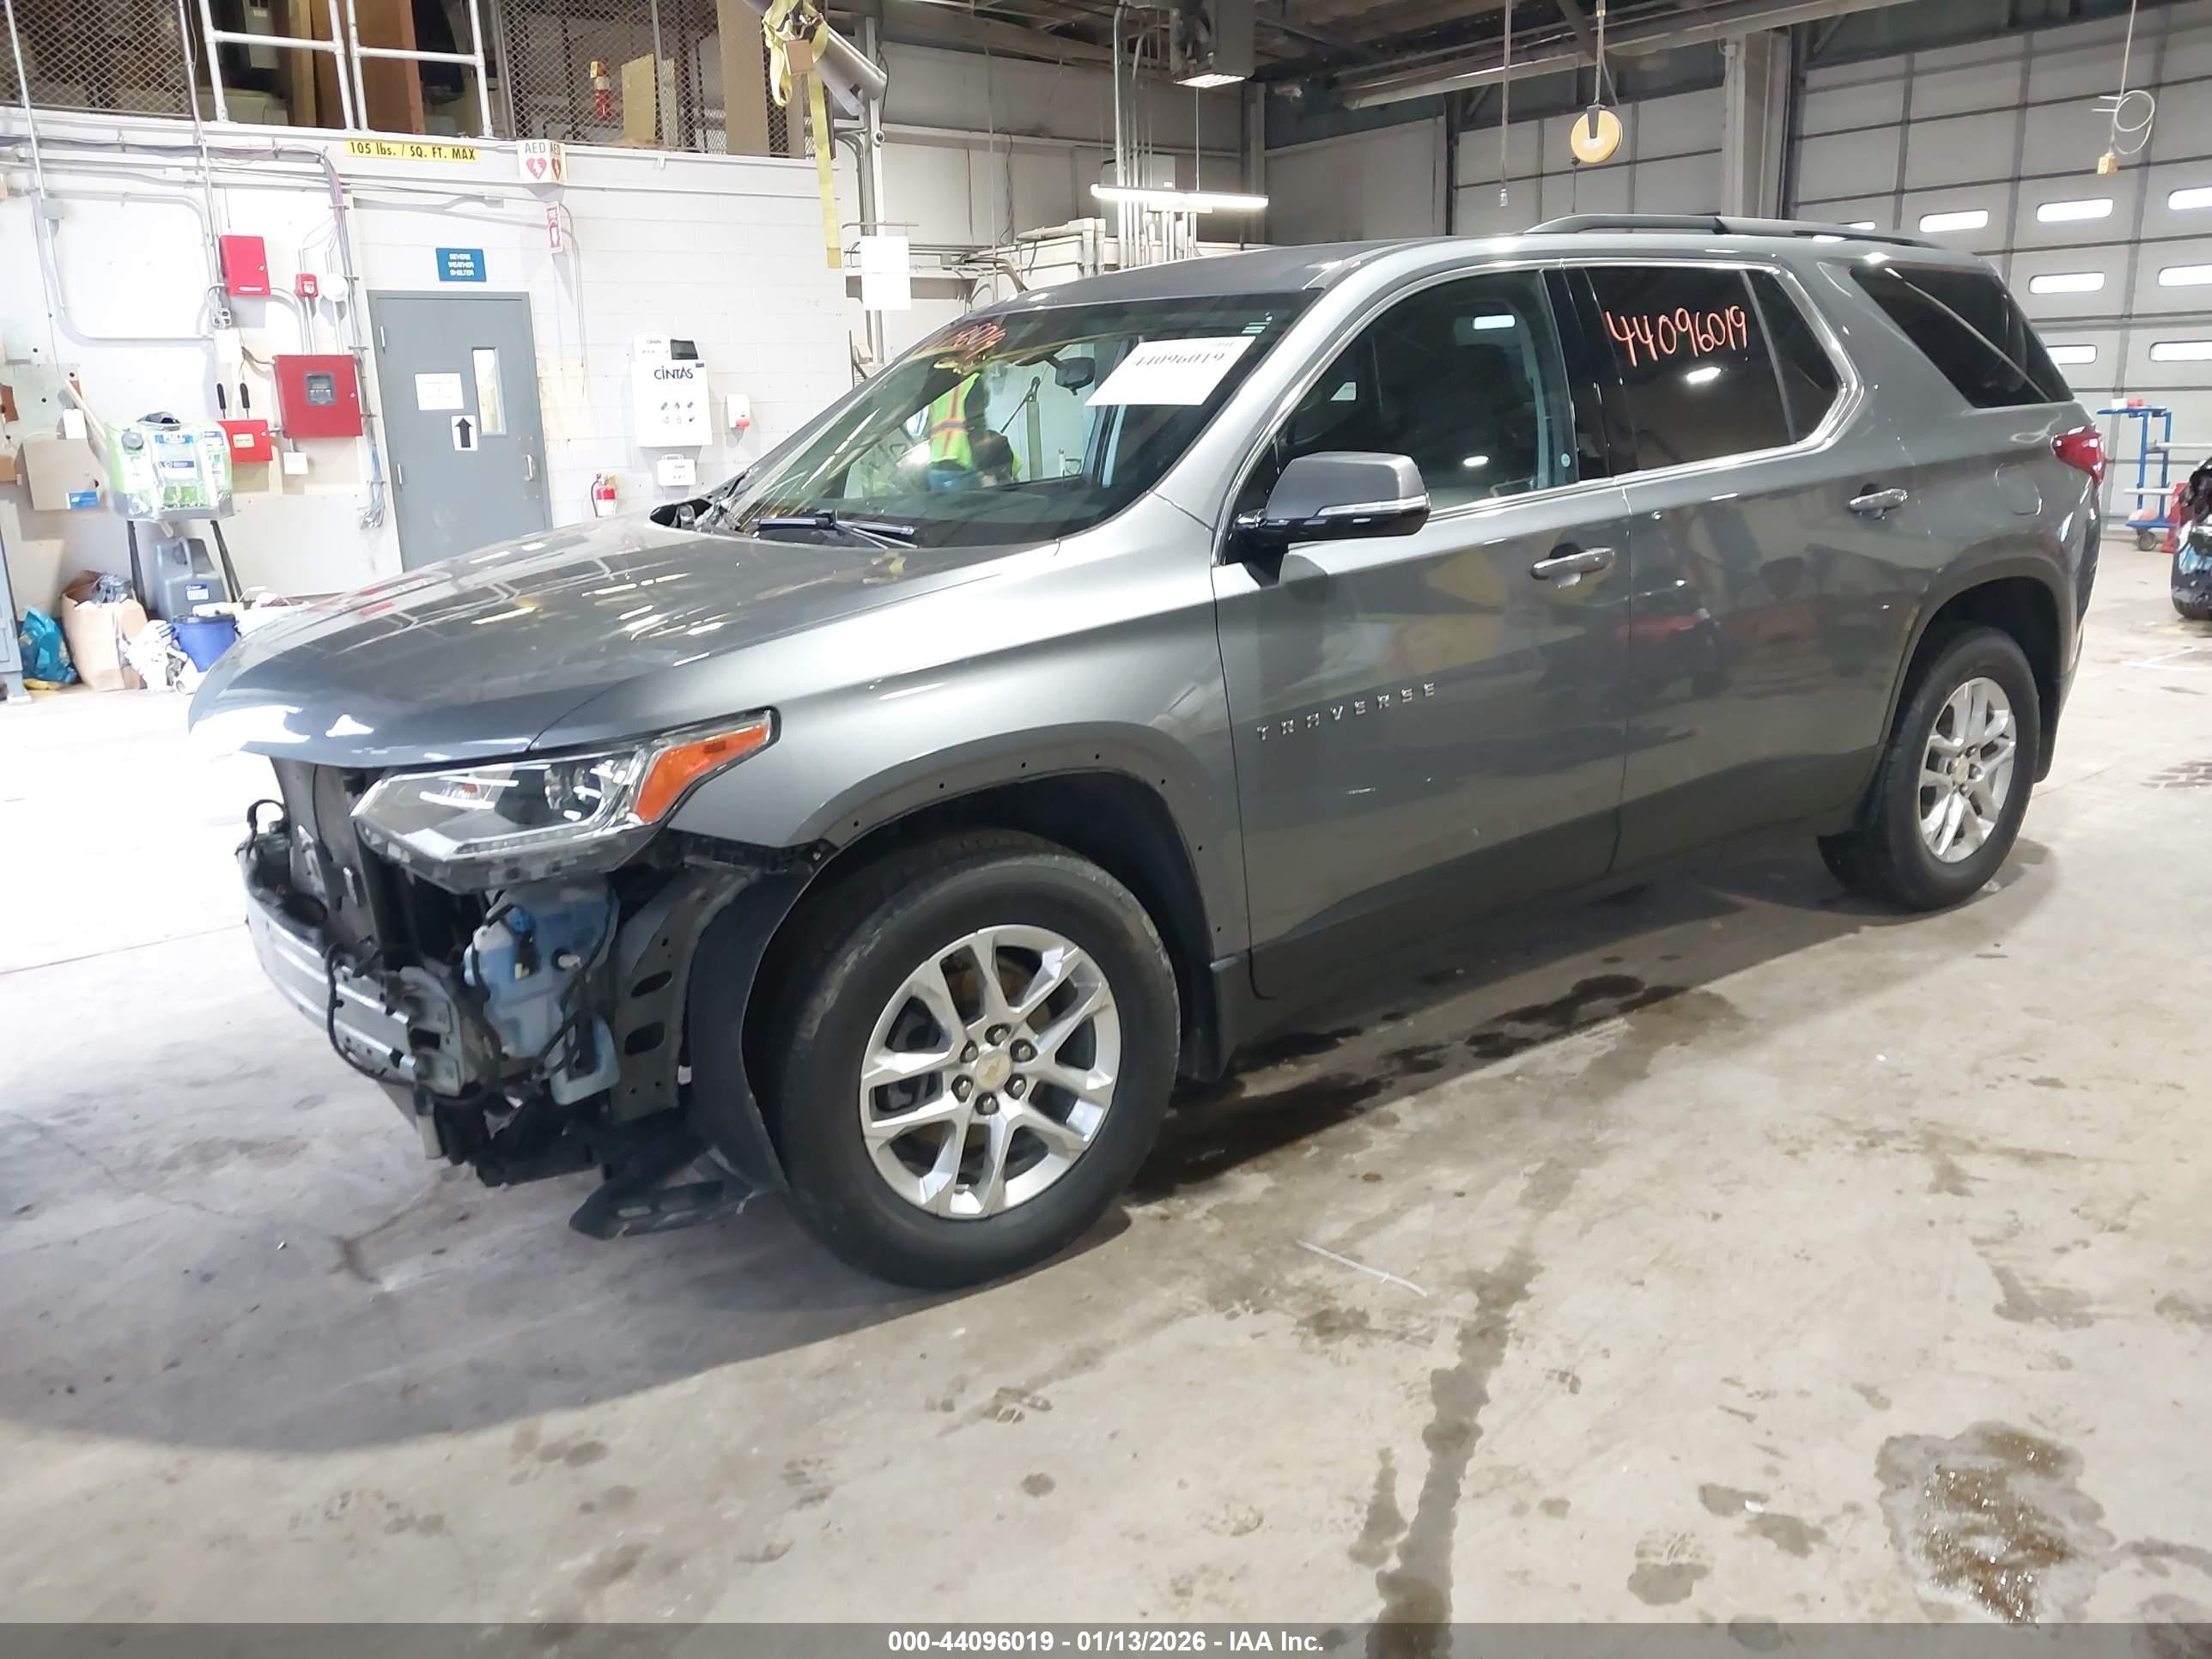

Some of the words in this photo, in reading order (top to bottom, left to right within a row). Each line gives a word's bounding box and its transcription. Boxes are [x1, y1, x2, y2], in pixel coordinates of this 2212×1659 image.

[350, 142, 371, 154] 105
[376, 143, 396, 155] lbs.
[401, 143, 405, 156] /
[410, 145, 428, 159] SQ.
[432, 147, 447, 159] FT.
[452, 148, 476, 160] MAX
[525, 142, 546, 154] AED
[550, 143, 561, 155] AED
[1605, 305, 1748, 368] 44096019
[1133, 352, 1226, 367] 44096019
[653, 365, 694, 380] CINTAS
[1256, 682, 1436, 741] TRAVERSE
